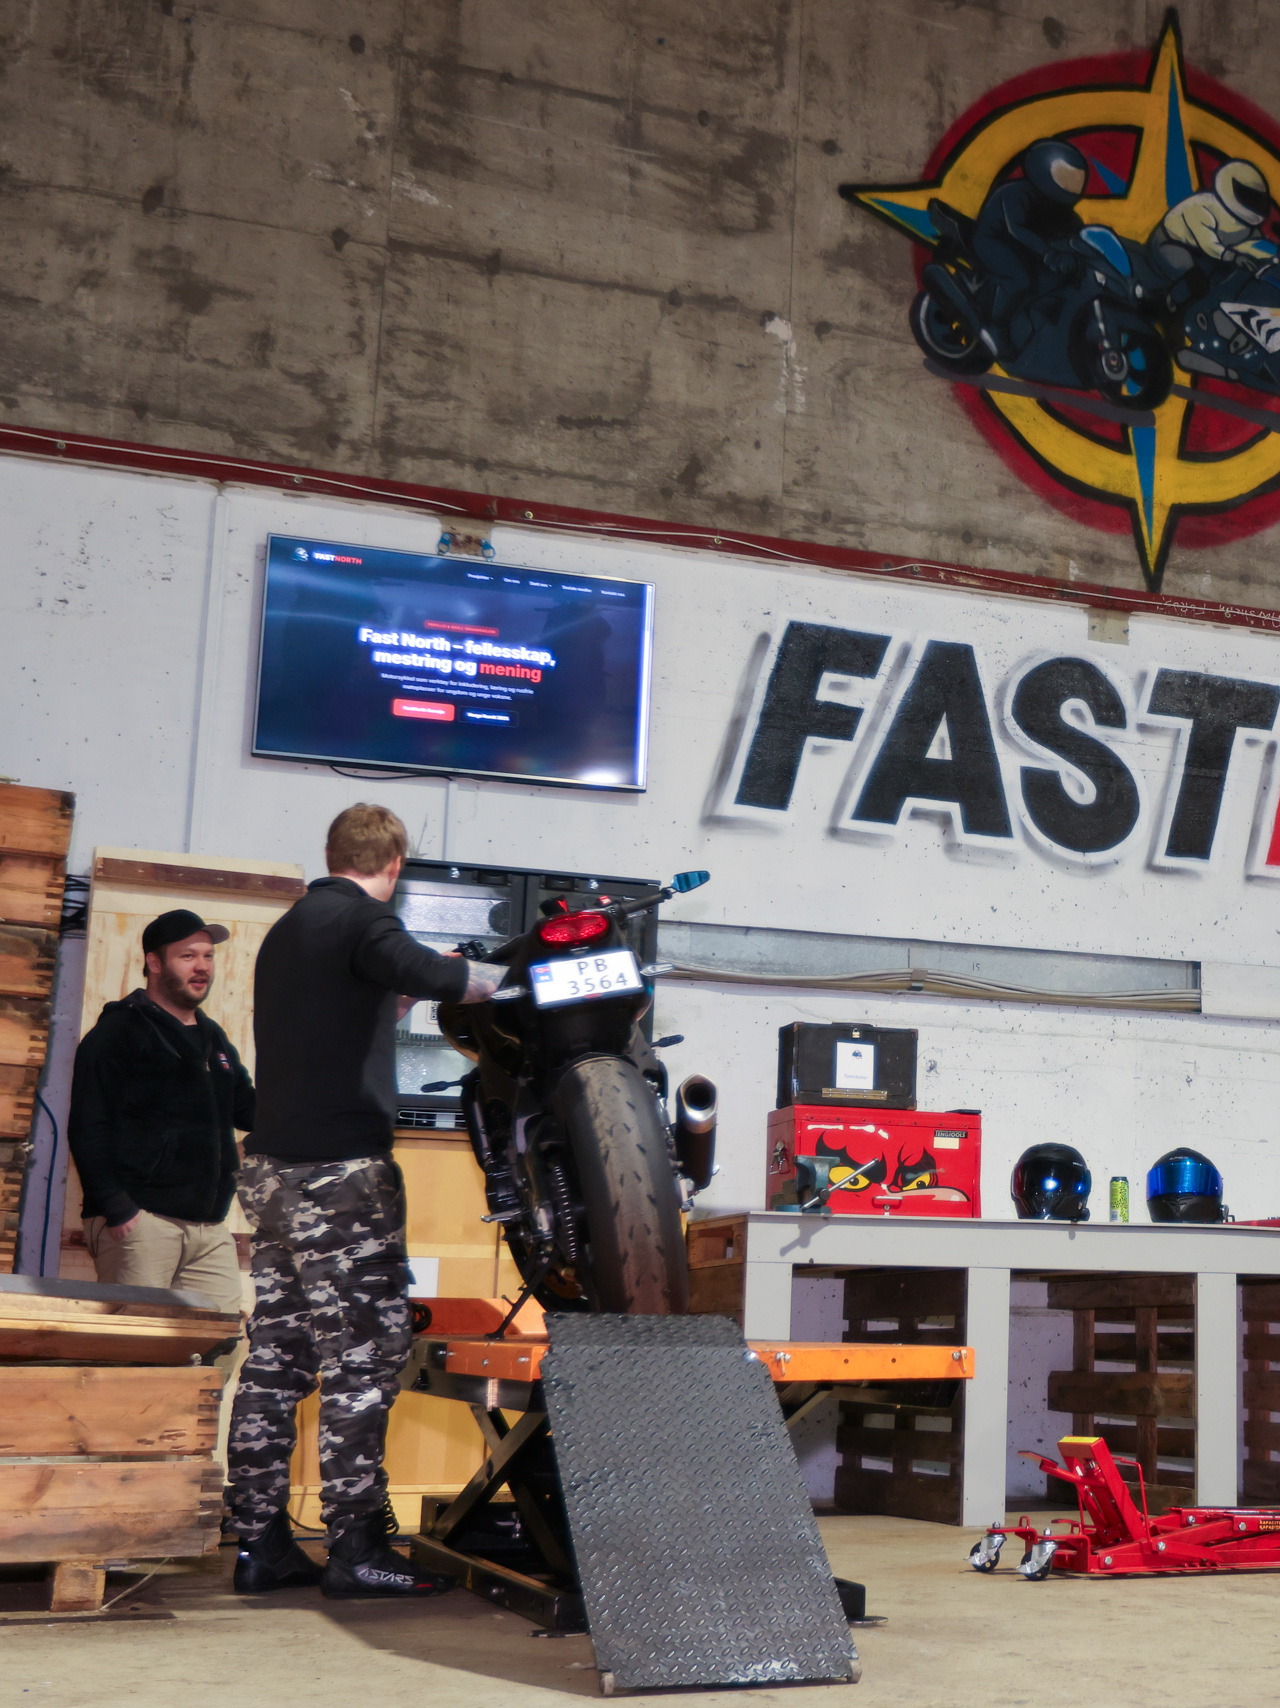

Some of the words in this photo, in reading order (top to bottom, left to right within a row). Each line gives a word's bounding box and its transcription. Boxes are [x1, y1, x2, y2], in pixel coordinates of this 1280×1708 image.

[360, 627, 400, 646] Fast
[401, 632, 451, 652] North
[465, 639, 557, 667] fellesskap,
[373, 651, 452, 674] mestring
[453, 660, 477, 676] og
[480, 663, 542, 684] mening
[577, 958, 608, 975] PB
[567, 972, 628, 996] 3564
